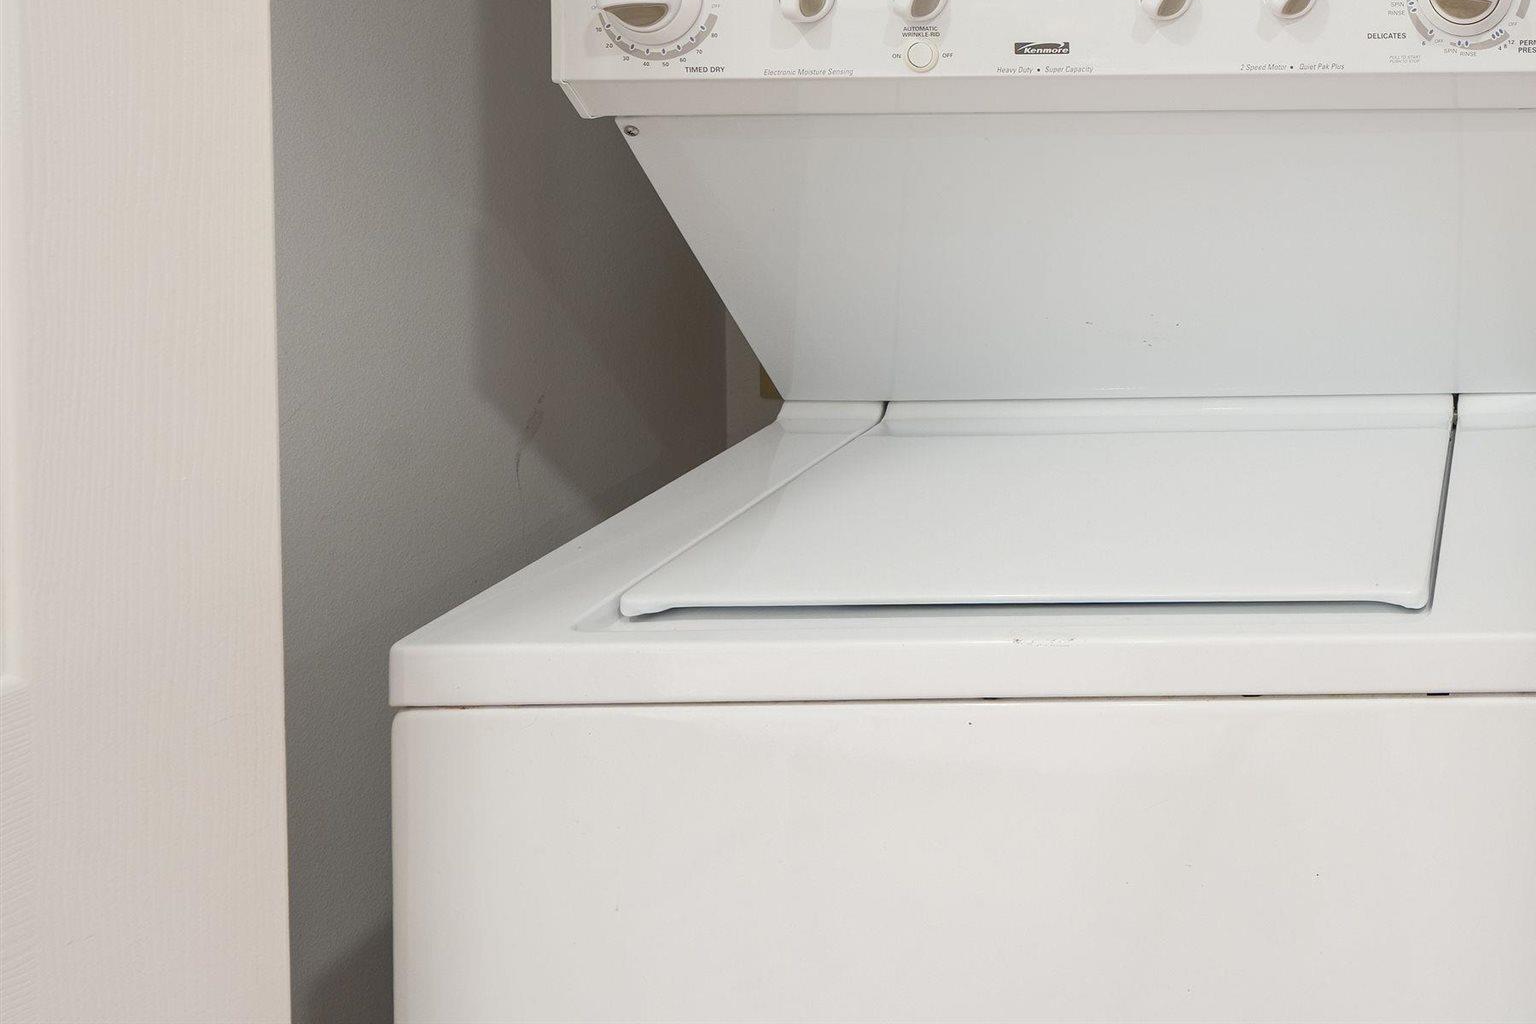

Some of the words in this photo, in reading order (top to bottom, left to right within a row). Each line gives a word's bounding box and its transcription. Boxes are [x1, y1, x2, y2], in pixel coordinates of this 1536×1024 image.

[1368, 32, 1406, 40] DELICATES
[1023, 46, 1069, 54] Kenmore
[997, 66, 1016, 74] Heavy
[1018, 66, 1033, 74] Duty
[1045, 66, 1064, 74] Super
[1066, 66, 1094, 74] Capacity
[1246, 64, 1266, 73] Speed
[1268, 63, 1287, 71] Motor
[1300, 63, 1316, 72] Quiet
[764, 68, 796, 76] Electronic
[798, 68, 826, 76] Moisture
[828, 68, 854, 76] Sensing
